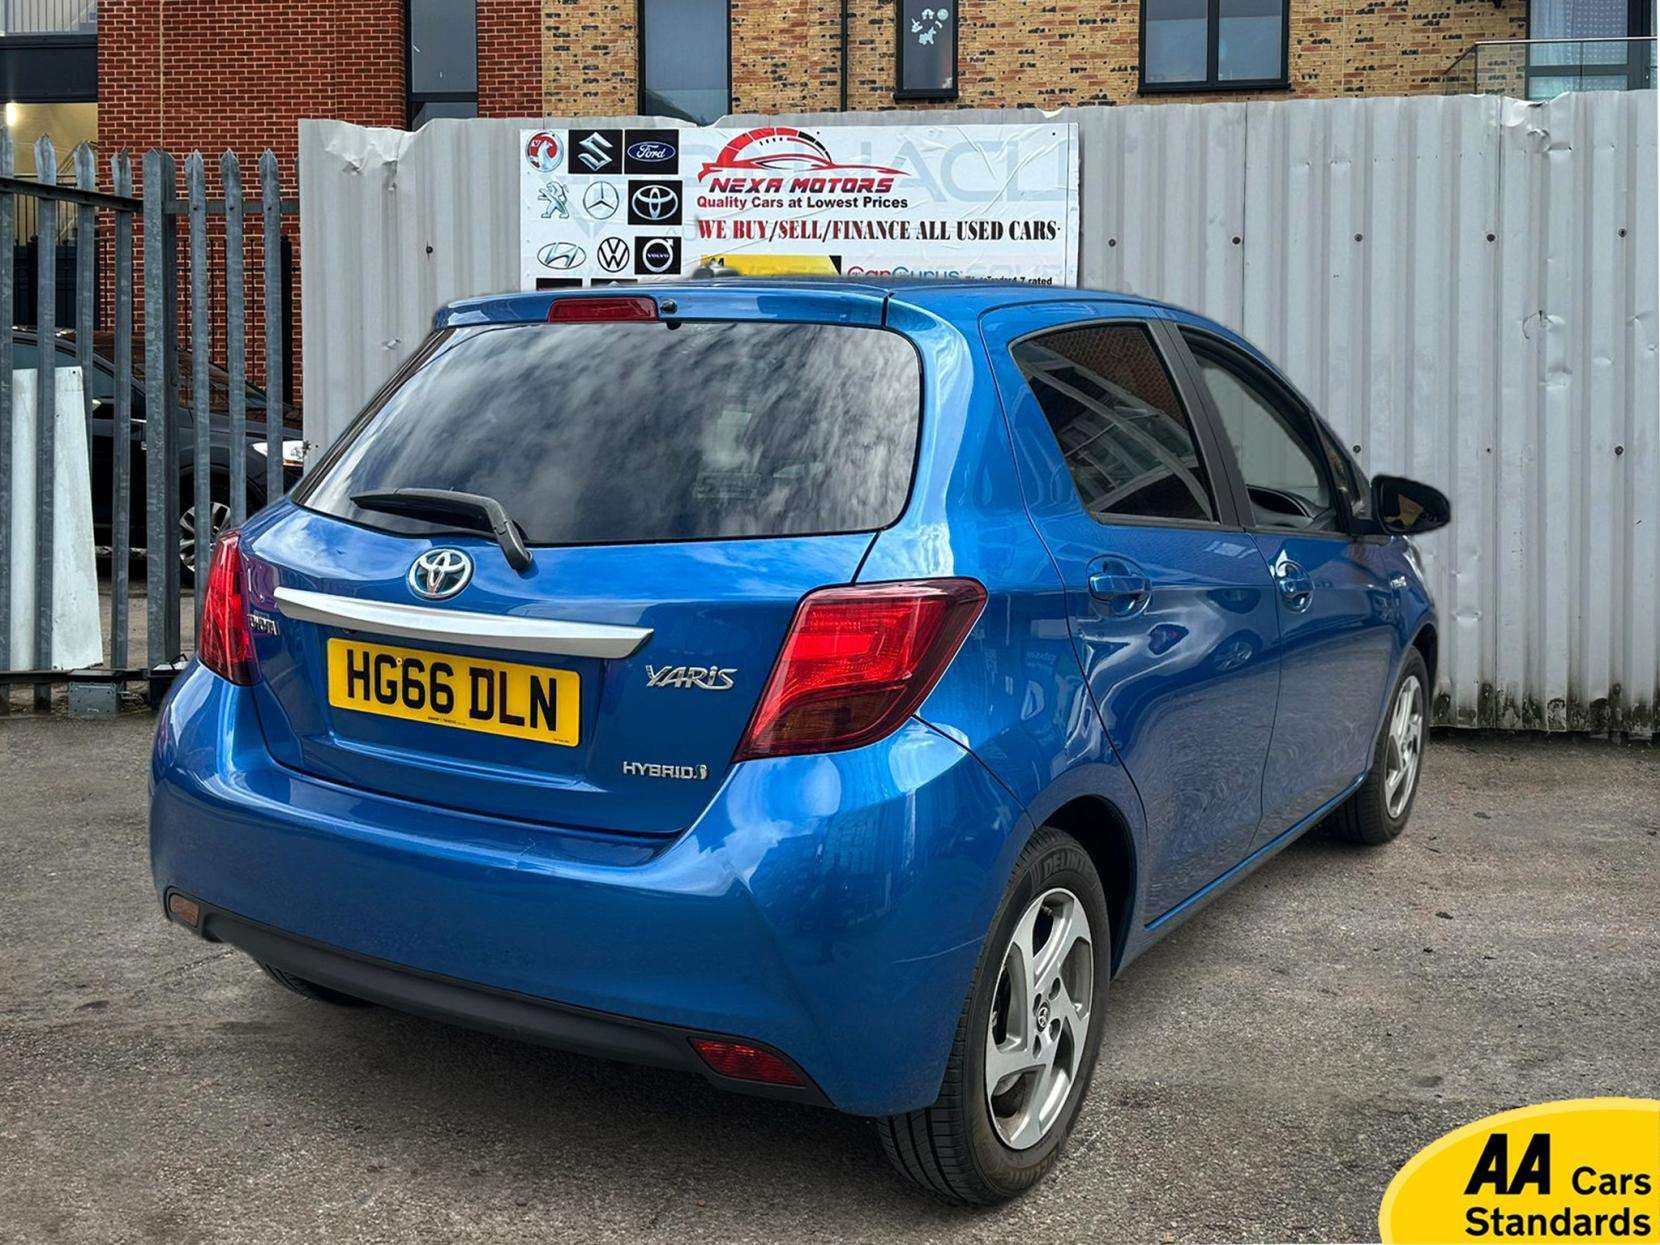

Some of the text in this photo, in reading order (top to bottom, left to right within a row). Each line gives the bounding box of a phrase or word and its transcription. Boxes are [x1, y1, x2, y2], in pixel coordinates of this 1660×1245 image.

[636, 143, 667, 160] Ford
[709, 177, 895, 194] NEXA MOTORS
[697, 196, 909, 210] Quality Cars at Lowest Prices
[697, 219, 727, 241] WE
[732, 219, 911, 242] BUY/SELL/FINANCE
[915, 219, 952, 241] ALL
[956, 219, 1004, 241] USED
[1008, 219, 1057, 241] CARS
[1028, 276, 1053, 286] rated
[346, 648, 558, 732] HG66 DLN
[622, 760, 694, 779] HYBRID
